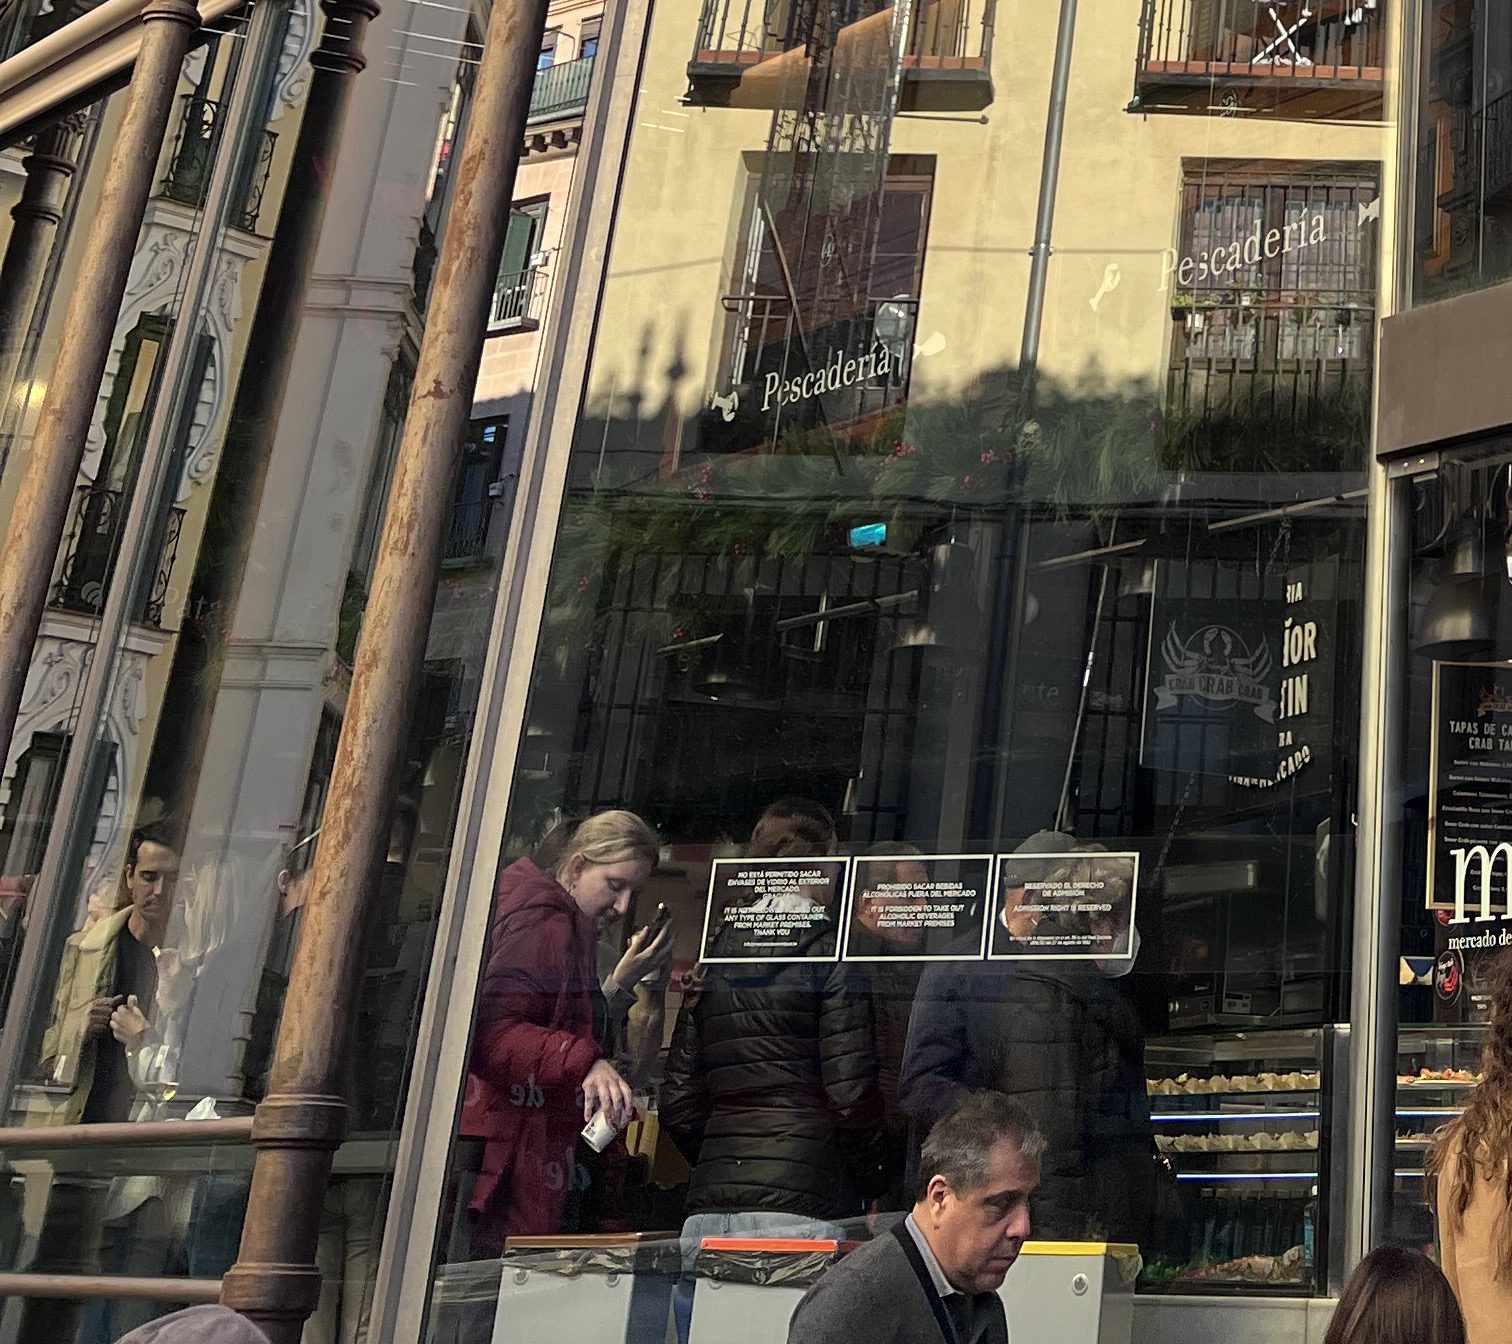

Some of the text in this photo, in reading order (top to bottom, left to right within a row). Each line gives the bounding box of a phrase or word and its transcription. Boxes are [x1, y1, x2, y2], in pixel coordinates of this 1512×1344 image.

[1158, 207, 1327, 292] Pescadería
[760, 340, 890, 411] Pescadería
[1200, 675, 1234, 696] CRAB
[1449, 720, 1478, 734] TAPAS
[1483, 723, 1496, 735] DE
[1468, 736, 1493, 750] CRAB
[1448, 929, 1497, 950] mercado
[1498, 927, 1512, 946] de
